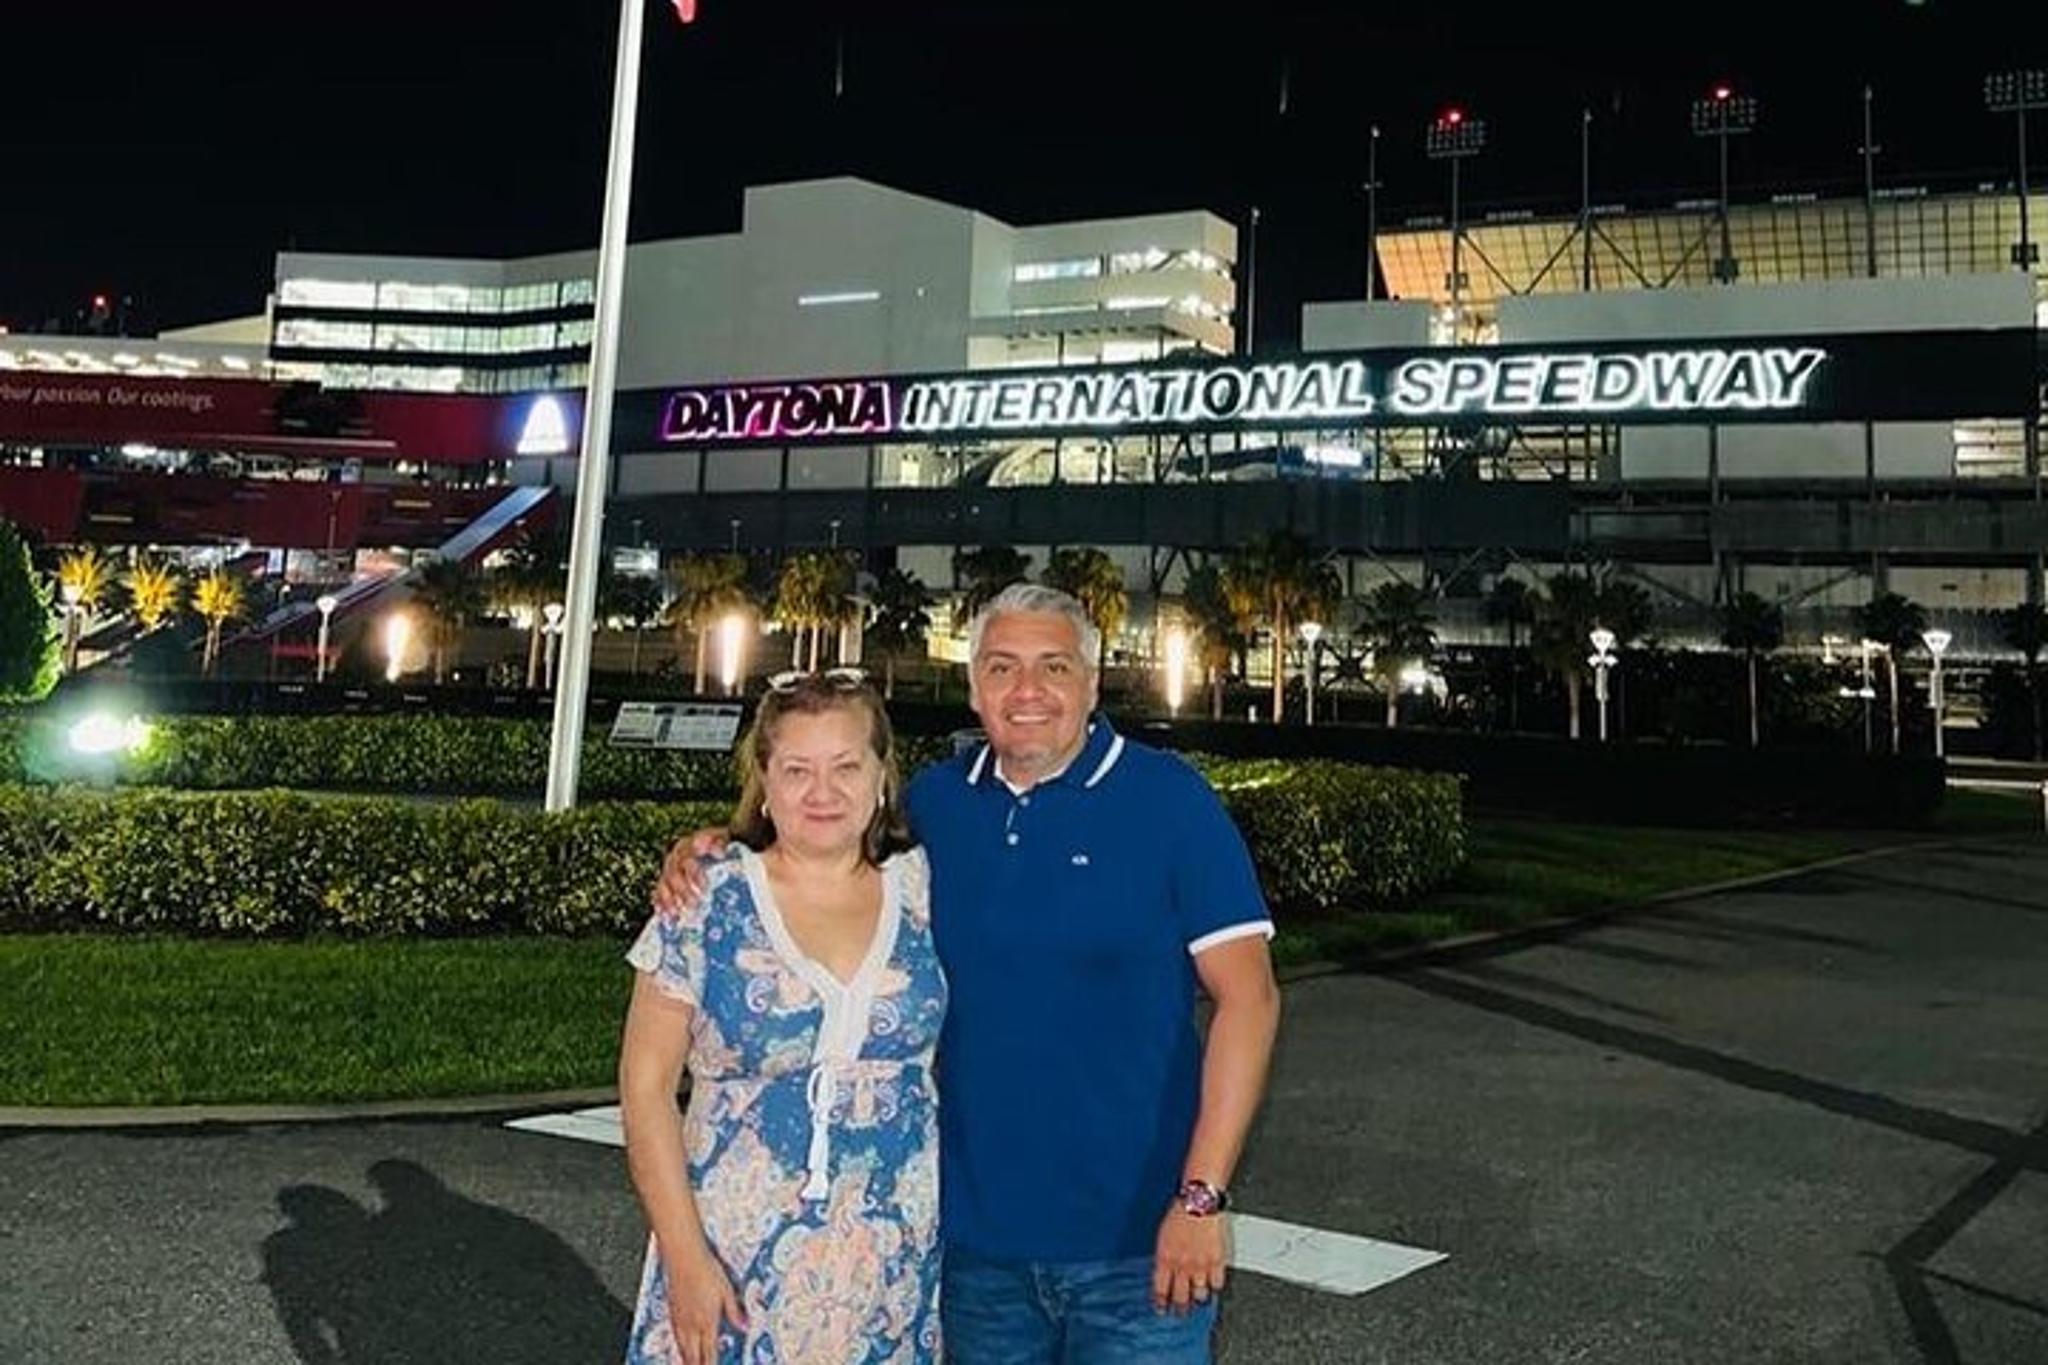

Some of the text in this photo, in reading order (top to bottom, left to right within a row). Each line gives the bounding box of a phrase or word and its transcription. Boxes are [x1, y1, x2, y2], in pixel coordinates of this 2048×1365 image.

[664, 348, 1825, 441] DAYTONA INTERNATIONAL SPEEDWAY
